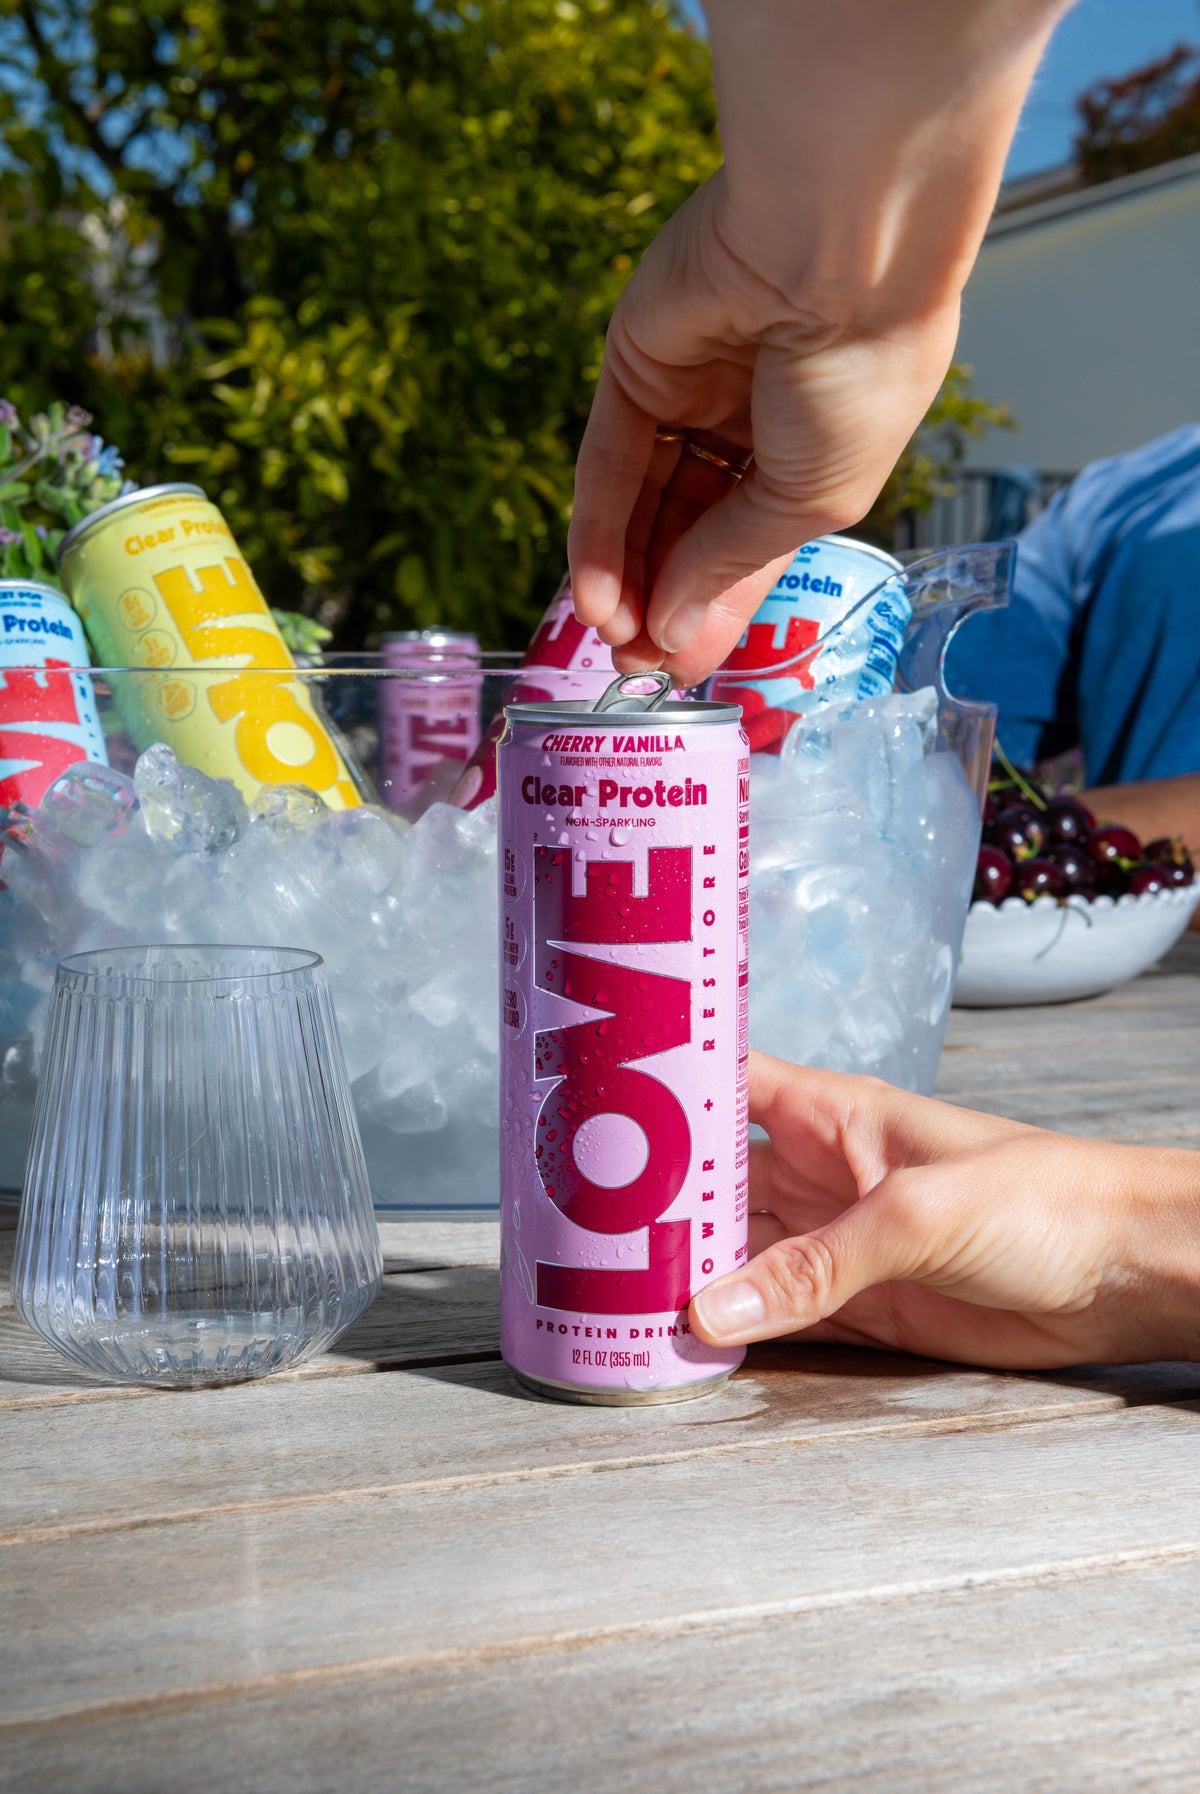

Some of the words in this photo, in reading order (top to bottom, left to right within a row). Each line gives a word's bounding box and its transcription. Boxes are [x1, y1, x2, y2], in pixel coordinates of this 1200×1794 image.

[124, 527, 175, 556] Clear
[776, 572, 842, 598] rotein
[2, 614, 74, 641] Protein
[152, 556, 364, 810] OVE
[541, 734, 606, 752] CHERRY
[612, 735, 686, 753] VANILLA
[560, 756, 584, 767] FLAVORED
[585, 757, 598, 767] WITH
[599, 757, 616, 767] OTHER
[616, 757, 639, 767] NATURAL
[640, 756, 663, 767] FLAVORS
[521, 775, 587, 807] Clear
[598, 777, 707, 808] Protein
[565, 817, 656, 828] NON-SPARKLING
[702, 844, 716, 1051] RESTORE
[533, 845, 693, 1317] LOVE
[701, 1158, 715, 1275] OWER
[536, 1319, 617, 1339] PROTEIN
[629, 1324, 692, 1340] DRINK
[572, 1349, 581, 1365] 12
[583, 1350, 592, 1366] FL
[595, 1351, 607, 1367] OZ
[610, 1351, 631, 1369] (355
[633, 1350, 650, 1368] mL)
